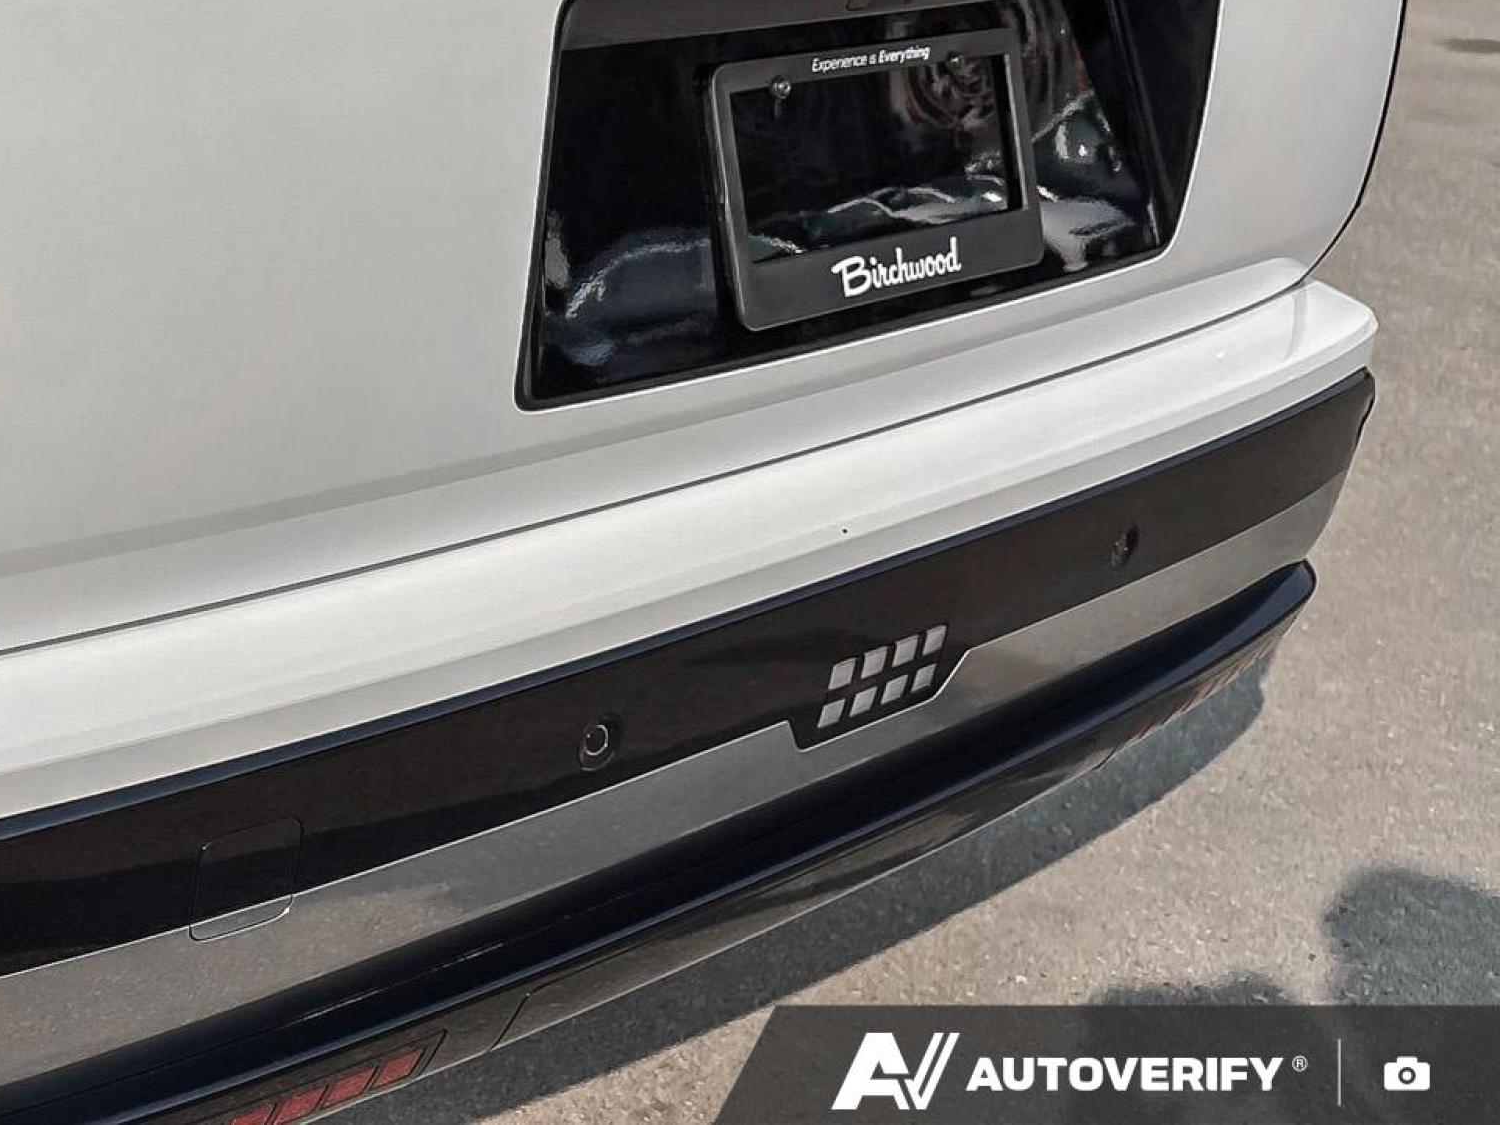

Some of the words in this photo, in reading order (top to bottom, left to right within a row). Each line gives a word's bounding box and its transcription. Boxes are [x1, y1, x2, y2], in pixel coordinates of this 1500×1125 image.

[811, 55, 868, 73] Experience
[878, 45, 931, 64] Everything
[830, 236, 962, 297] Birchwood
